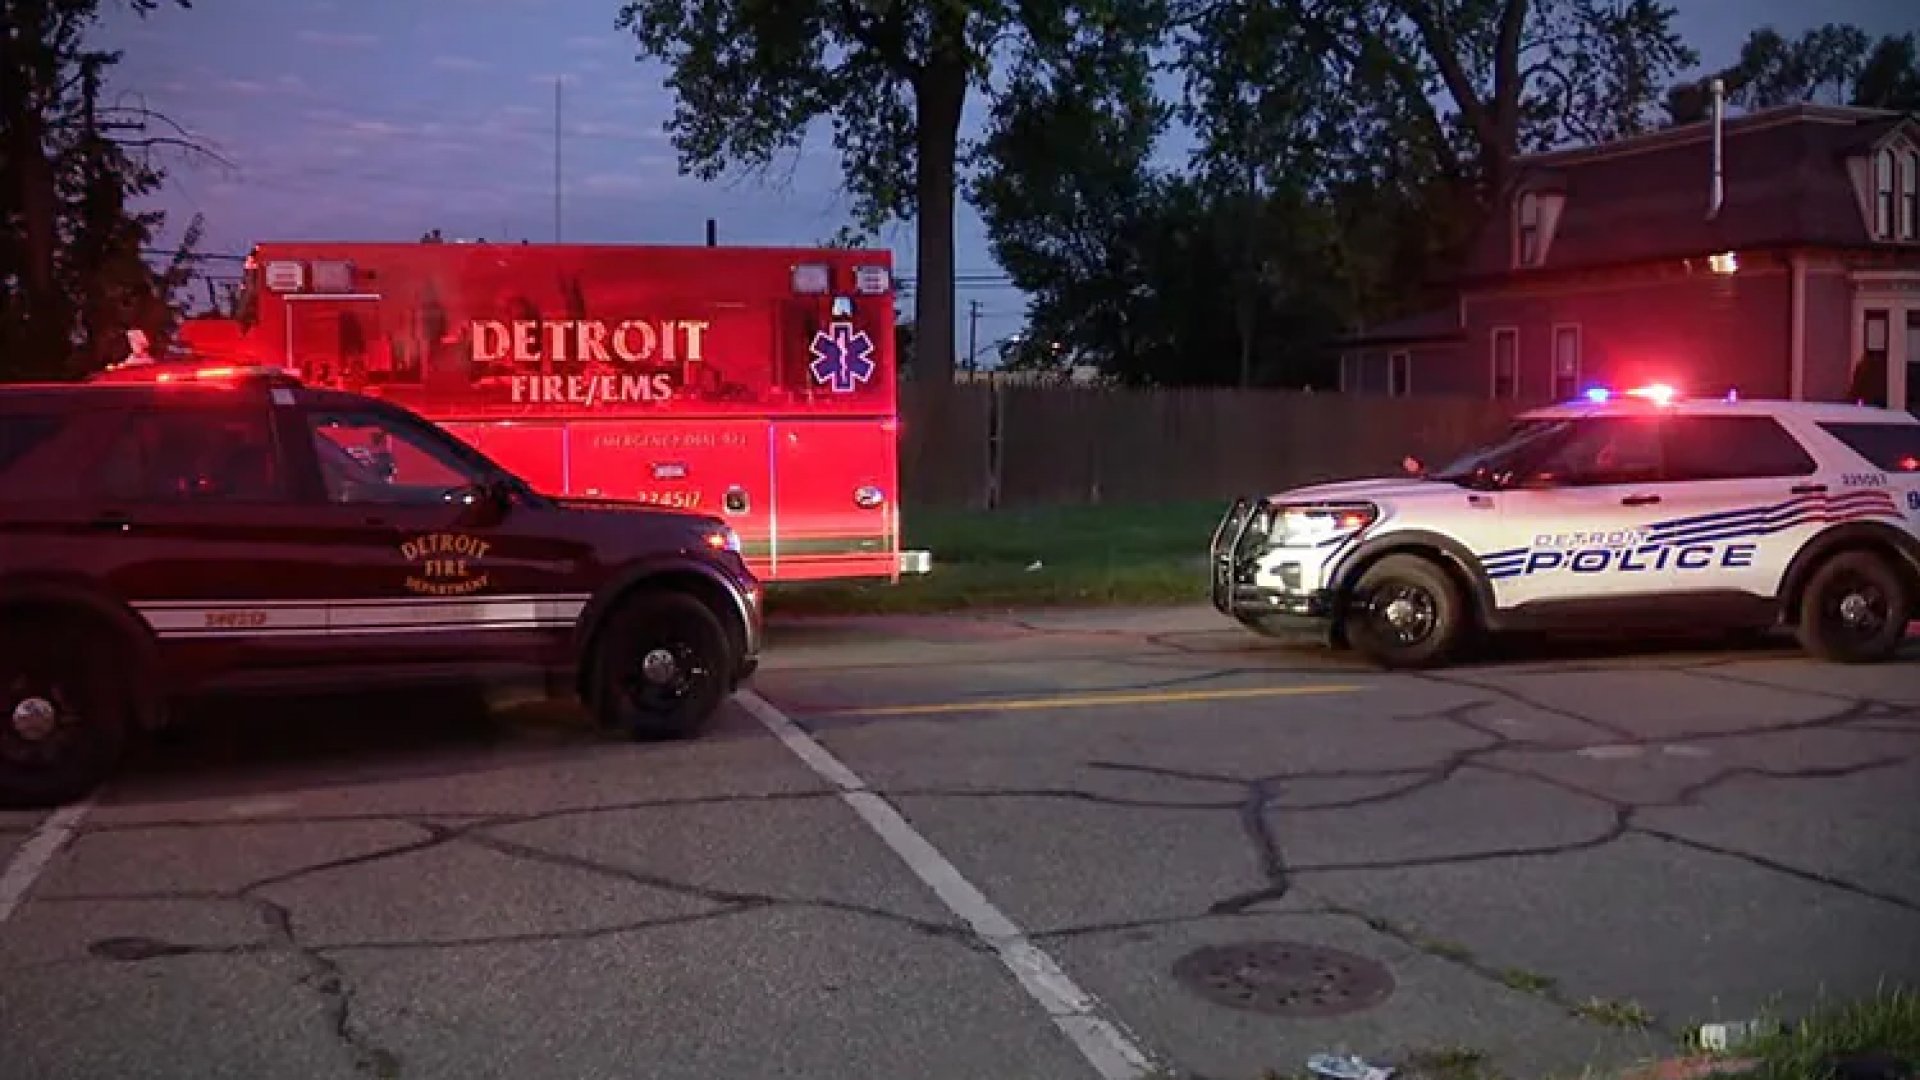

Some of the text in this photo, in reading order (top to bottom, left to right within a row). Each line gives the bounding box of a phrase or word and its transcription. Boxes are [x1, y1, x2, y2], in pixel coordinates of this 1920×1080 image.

[470, 319, 709, 363] DETROIT
[510, 373, 673, 405] FIRE/EMS
[401, 533, 491, 560] DETROIT
[1535, 529, 1651, 547] DETROIT
[424, 559, 470, 577] FIRE
[1525, 544, 1757, 574] POLICE
[405, 575, 488, 596] DEPARTMENT
